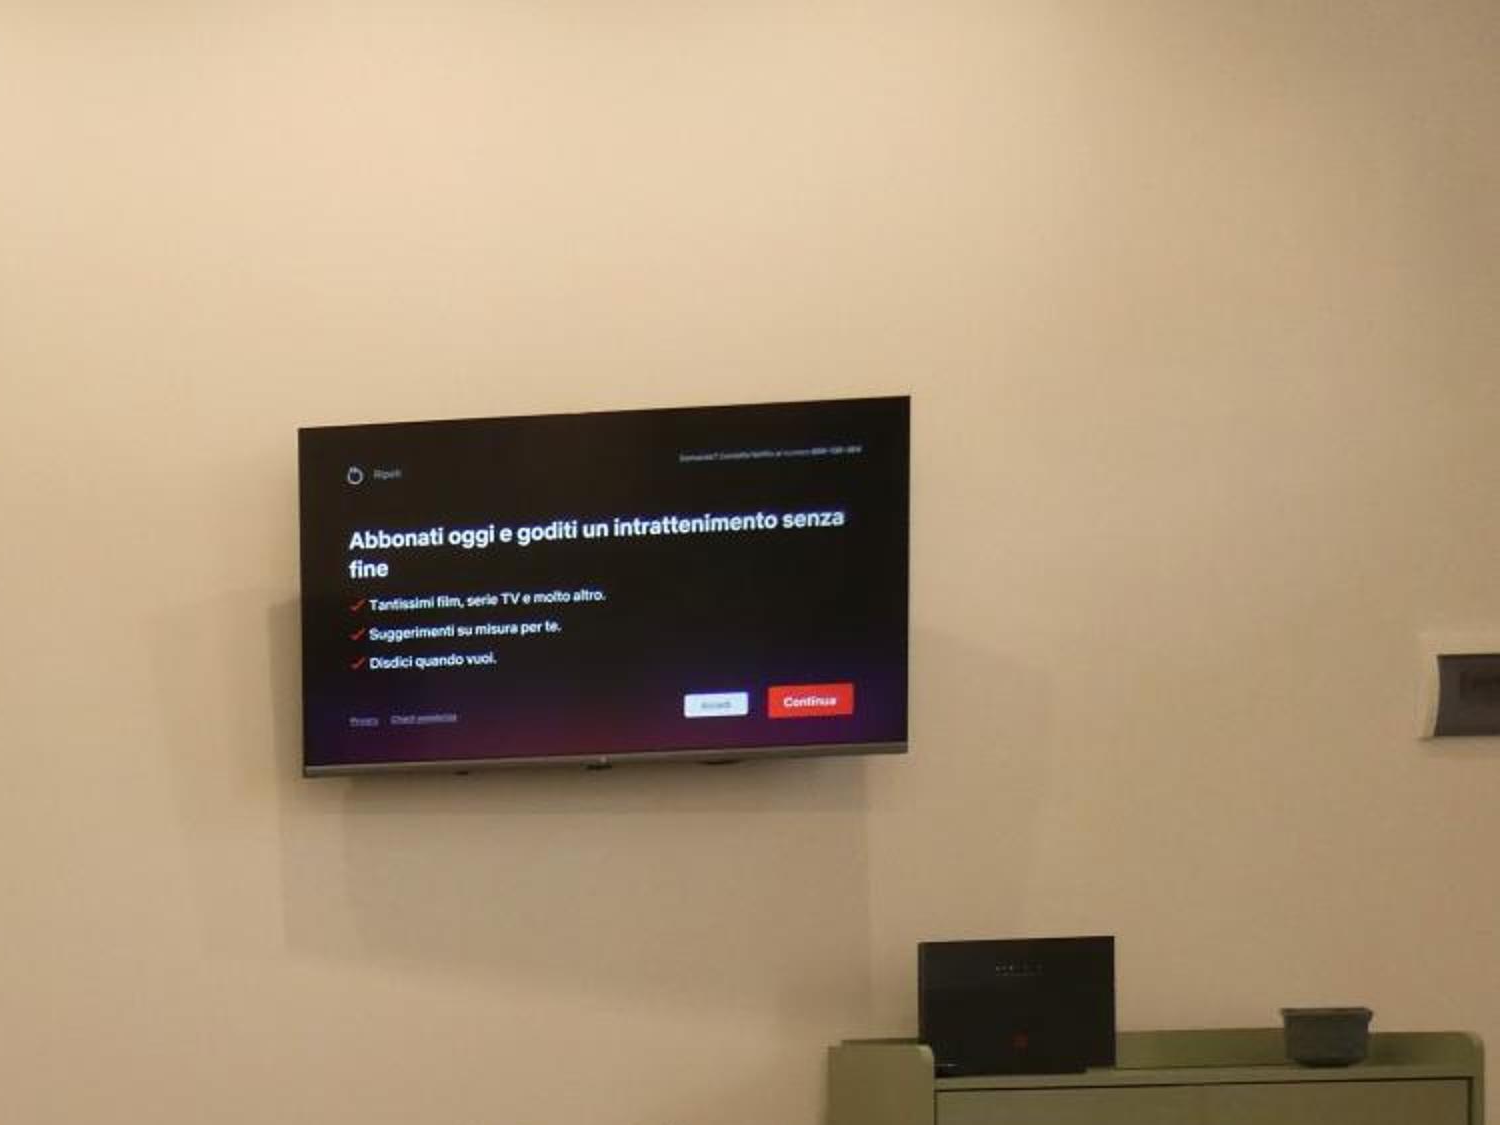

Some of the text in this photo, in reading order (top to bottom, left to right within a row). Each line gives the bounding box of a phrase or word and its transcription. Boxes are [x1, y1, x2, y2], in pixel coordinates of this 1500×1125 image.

[349, 510, 845, 549] Abbonati oggi e goditi un intrattenimento senza
[349, 560, 389, 578] fine
[369, 588, 606, 611] Tantissimi film, serie TV e molto altro.
[369, 620, 562, 643] Suggerimenti su misura per te.
[369, 652, 497, 670] Disdici quando vuoi.
[783, 696, 837, 708] Continua
